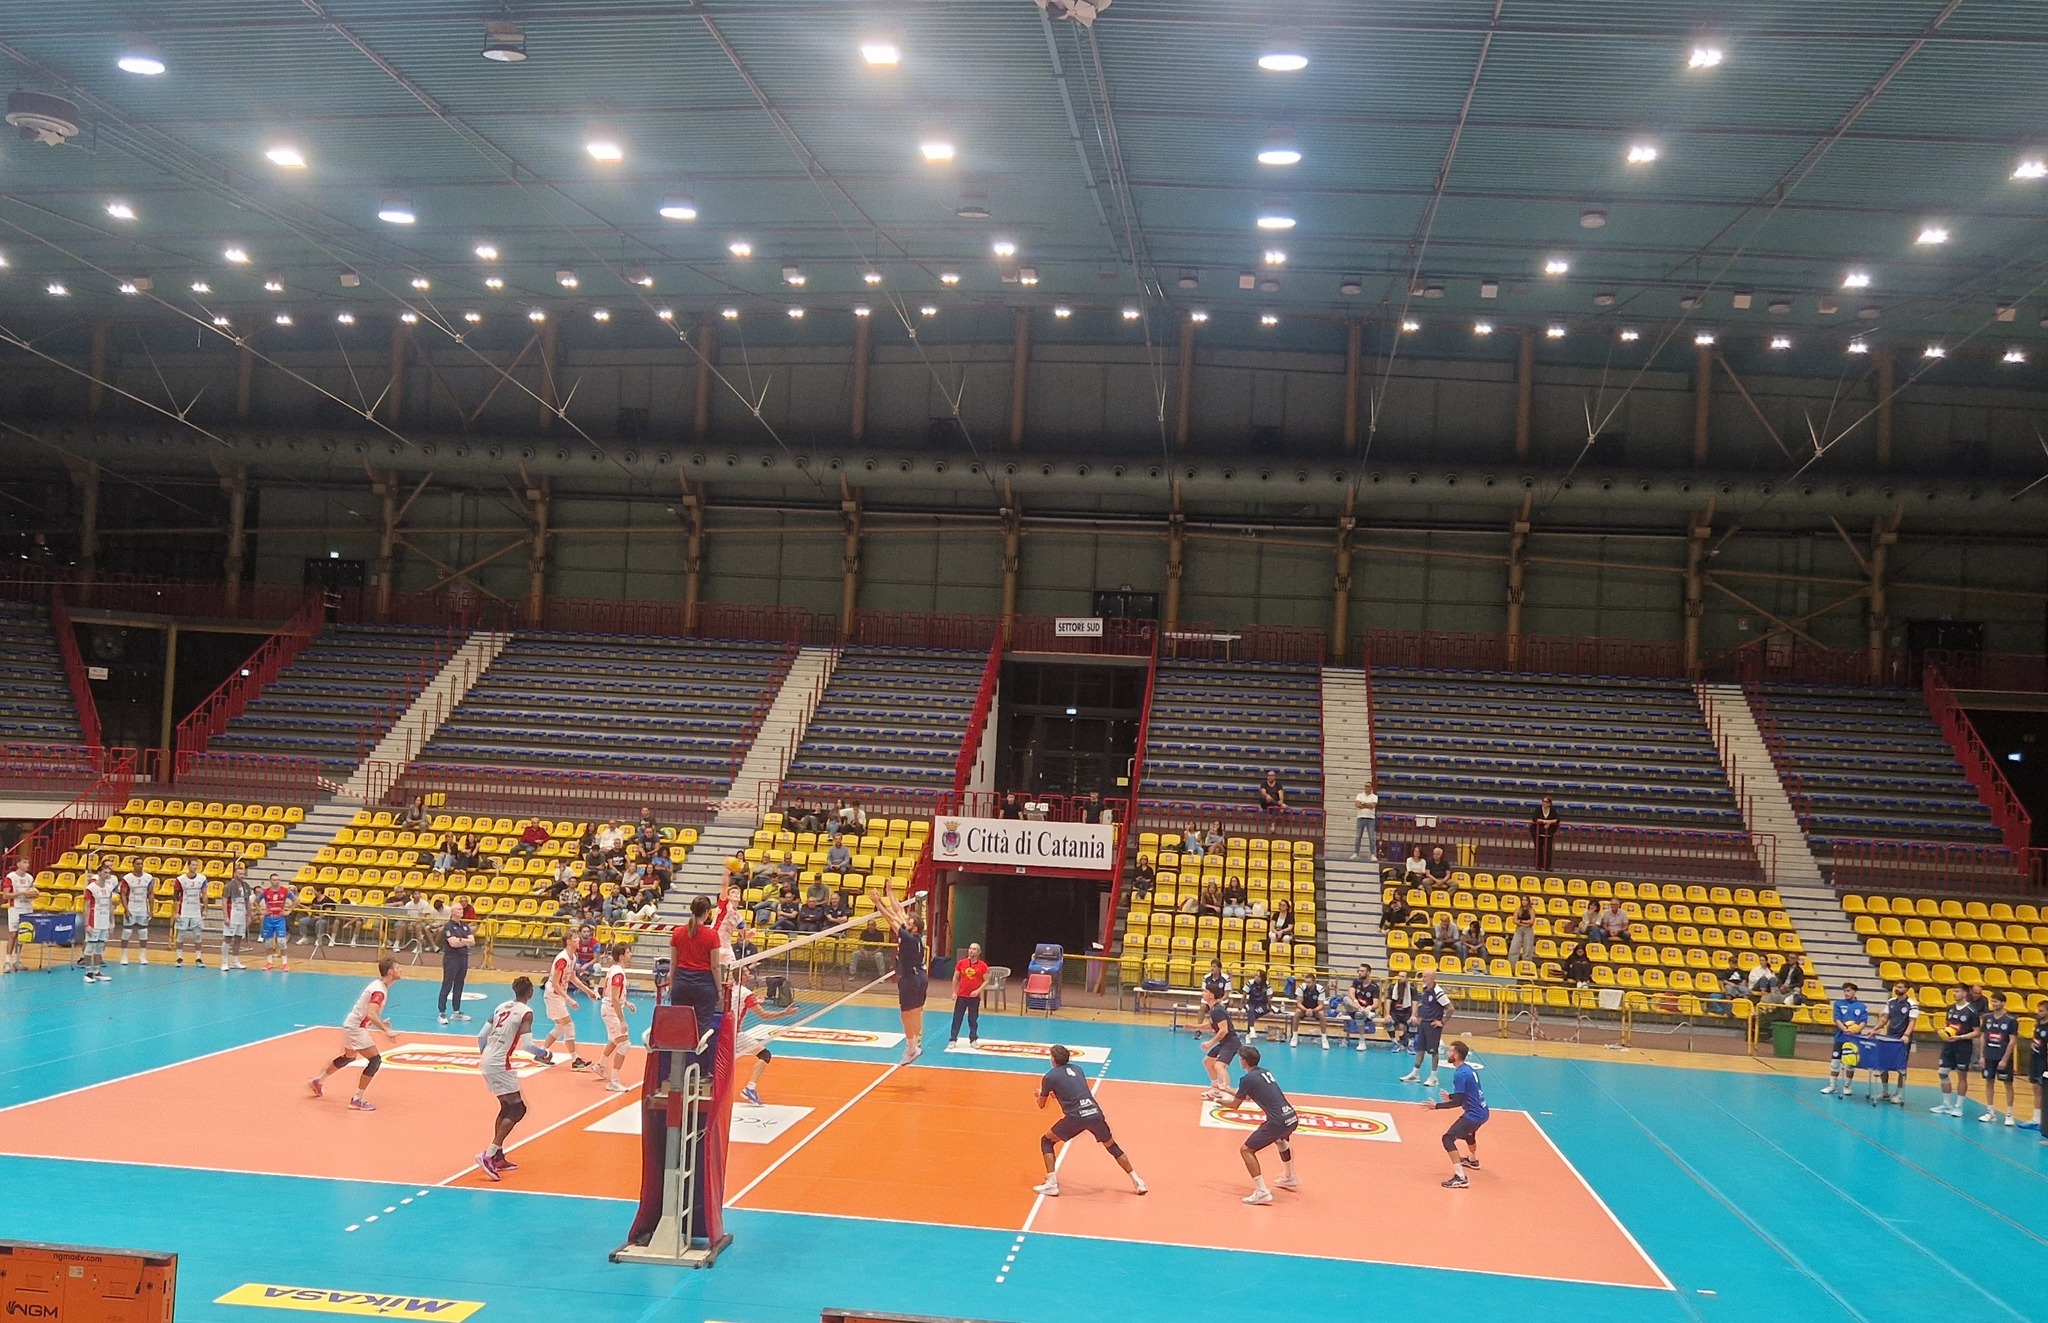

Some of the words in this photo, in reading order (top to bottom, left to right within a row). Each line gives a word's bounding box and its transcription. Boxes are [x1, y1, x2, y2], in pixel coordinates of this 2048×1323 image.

[1058, 622, 1085, 632] SETTORE
[1086, 622, 1100, 632] SUD
[967, 827, 1010, 854] Città
[1015, 830, 1032, 856] di
[1037, 831, 1106, 860] Catania
[14, 1303, 59, 1318] NGM
